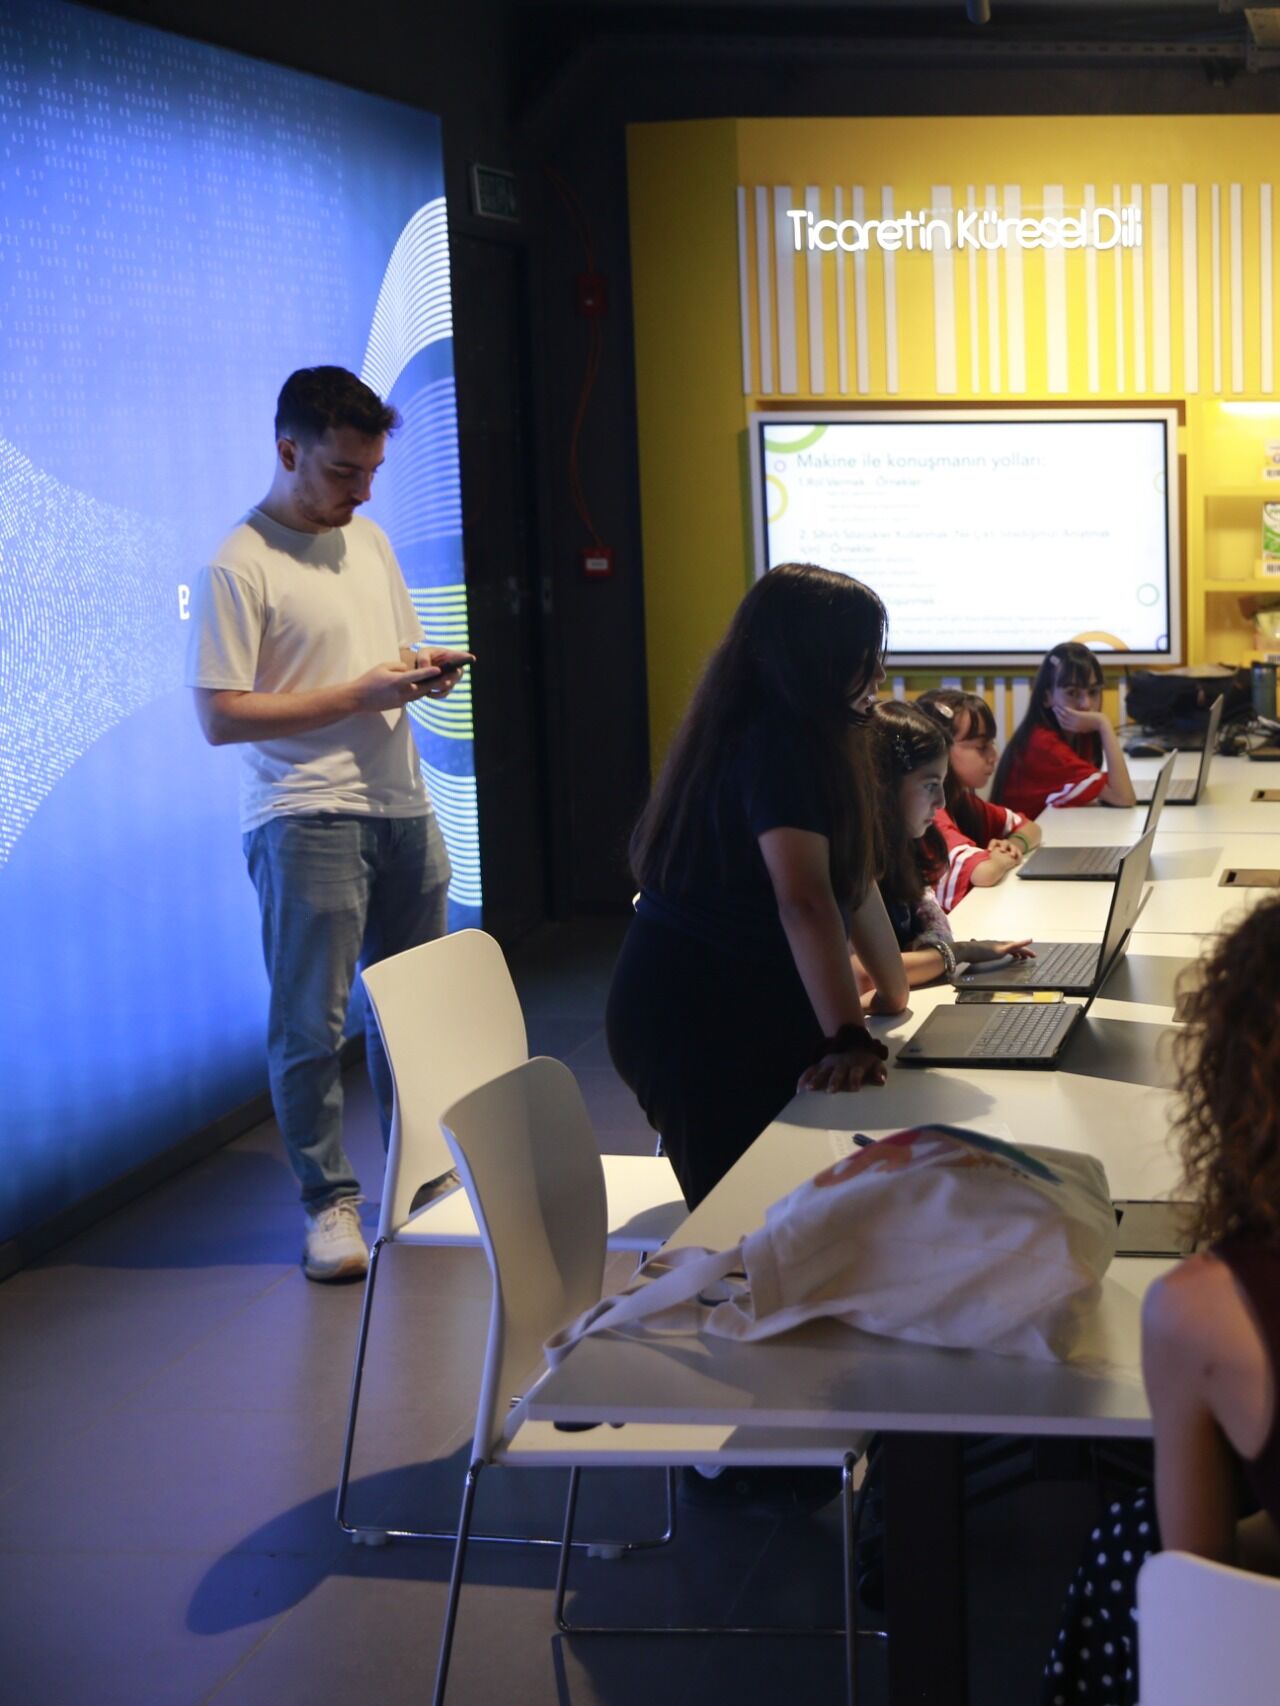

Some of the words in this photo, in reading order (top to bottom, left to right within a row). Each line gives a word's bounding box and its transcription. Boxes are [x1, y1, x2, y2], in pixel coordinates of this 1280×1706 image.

[786, 209, 951, 251] Ticaretin
[957, 208, 1087, 251] Küresel
[1094, 207, 1142, 250] Dili
[796, 453, 857, 469] Makine
[863, 453, 881, 469] ile
[887, 453, 986, 472] konuşmanın
